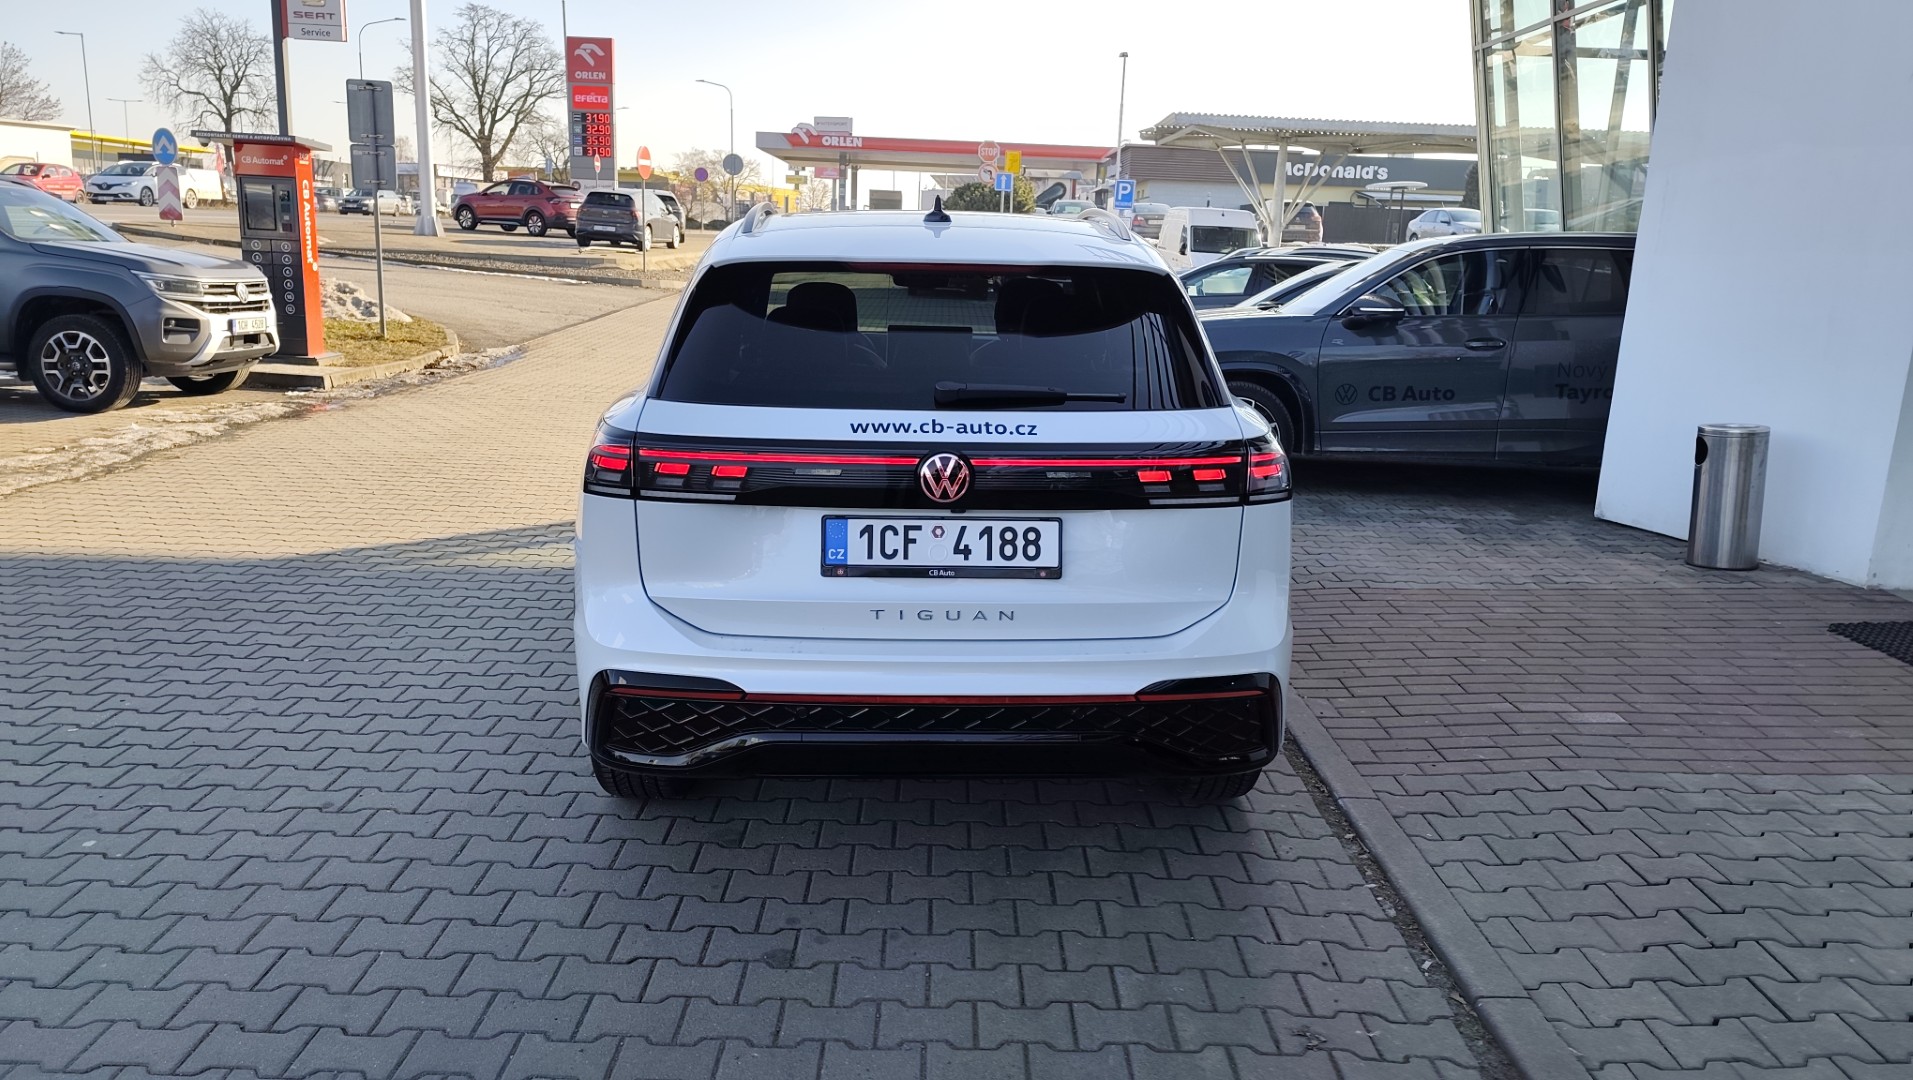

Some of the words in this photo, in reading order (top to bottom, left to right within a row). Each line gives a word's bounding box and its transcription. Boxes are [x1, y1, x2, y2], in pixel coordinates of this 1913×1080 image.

[293, 11, 336, 20] SEAT
[301, 28, 331, 37] Service
[575, 71, 606, 80] ORLEN
[822, 136, 862, 147] ORLEN
[586, 146, 611, 157] 3790
[981, 148, 998, 156] STOP
[302, 180, 310, 199] CB
[1118, 182, 1131, 200] P
[1557, 361, 1608, 381] Nový
[1368, 386, 1396, 402] CB
[1402, 386, 1456, 402] Auto
[850, 419, 1038, 436] www.cb-auto.cz
[860, 524, 922, 560] 1CF
[952, 526, 1042, 562] 4188
[828, 549, 845, 560] CZ
[870, 609, 1014, 621] TIGUAN
